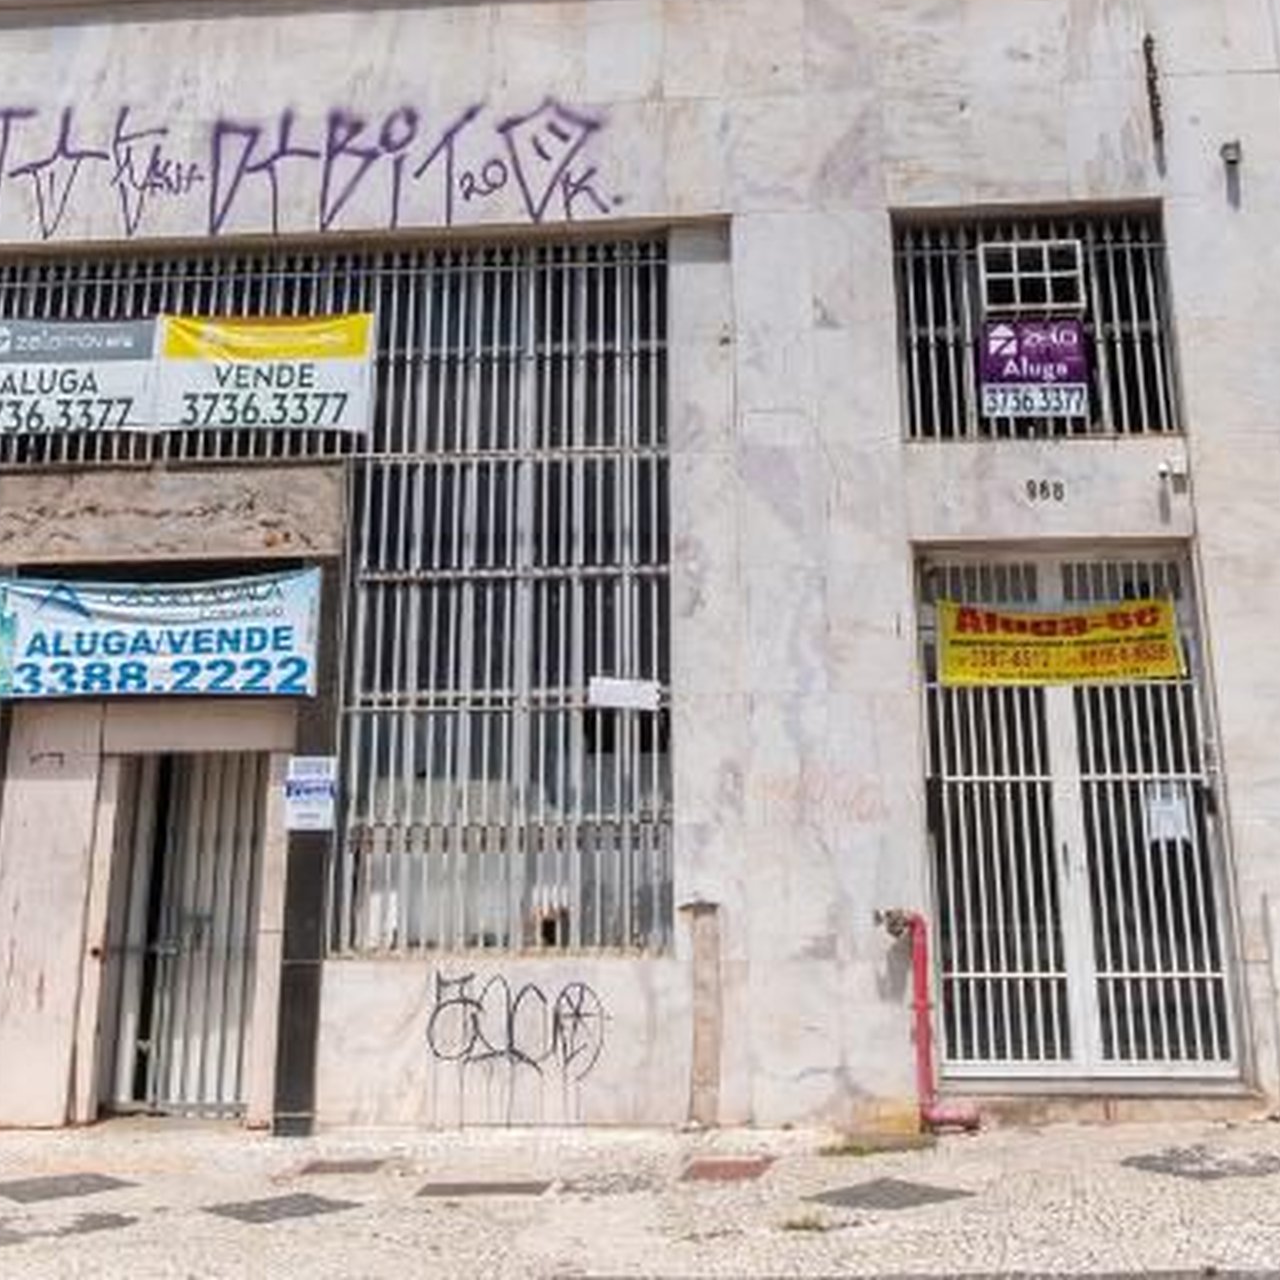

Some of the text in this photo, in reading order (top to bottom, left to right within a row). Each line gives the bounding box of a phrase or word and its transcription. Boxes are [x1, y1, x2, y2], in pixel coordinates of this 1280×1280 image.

[0, 369, 100, 396] ALUGA
[214, 362, 317, 388] VENDE
[1001, 355, 1069, 380] Aluga
[181, 392, 349, 426] 3736.3377
[25, 625, 296, 658] ALUGA/VENDE
[12, 656, 311, 694] 3388.2222
